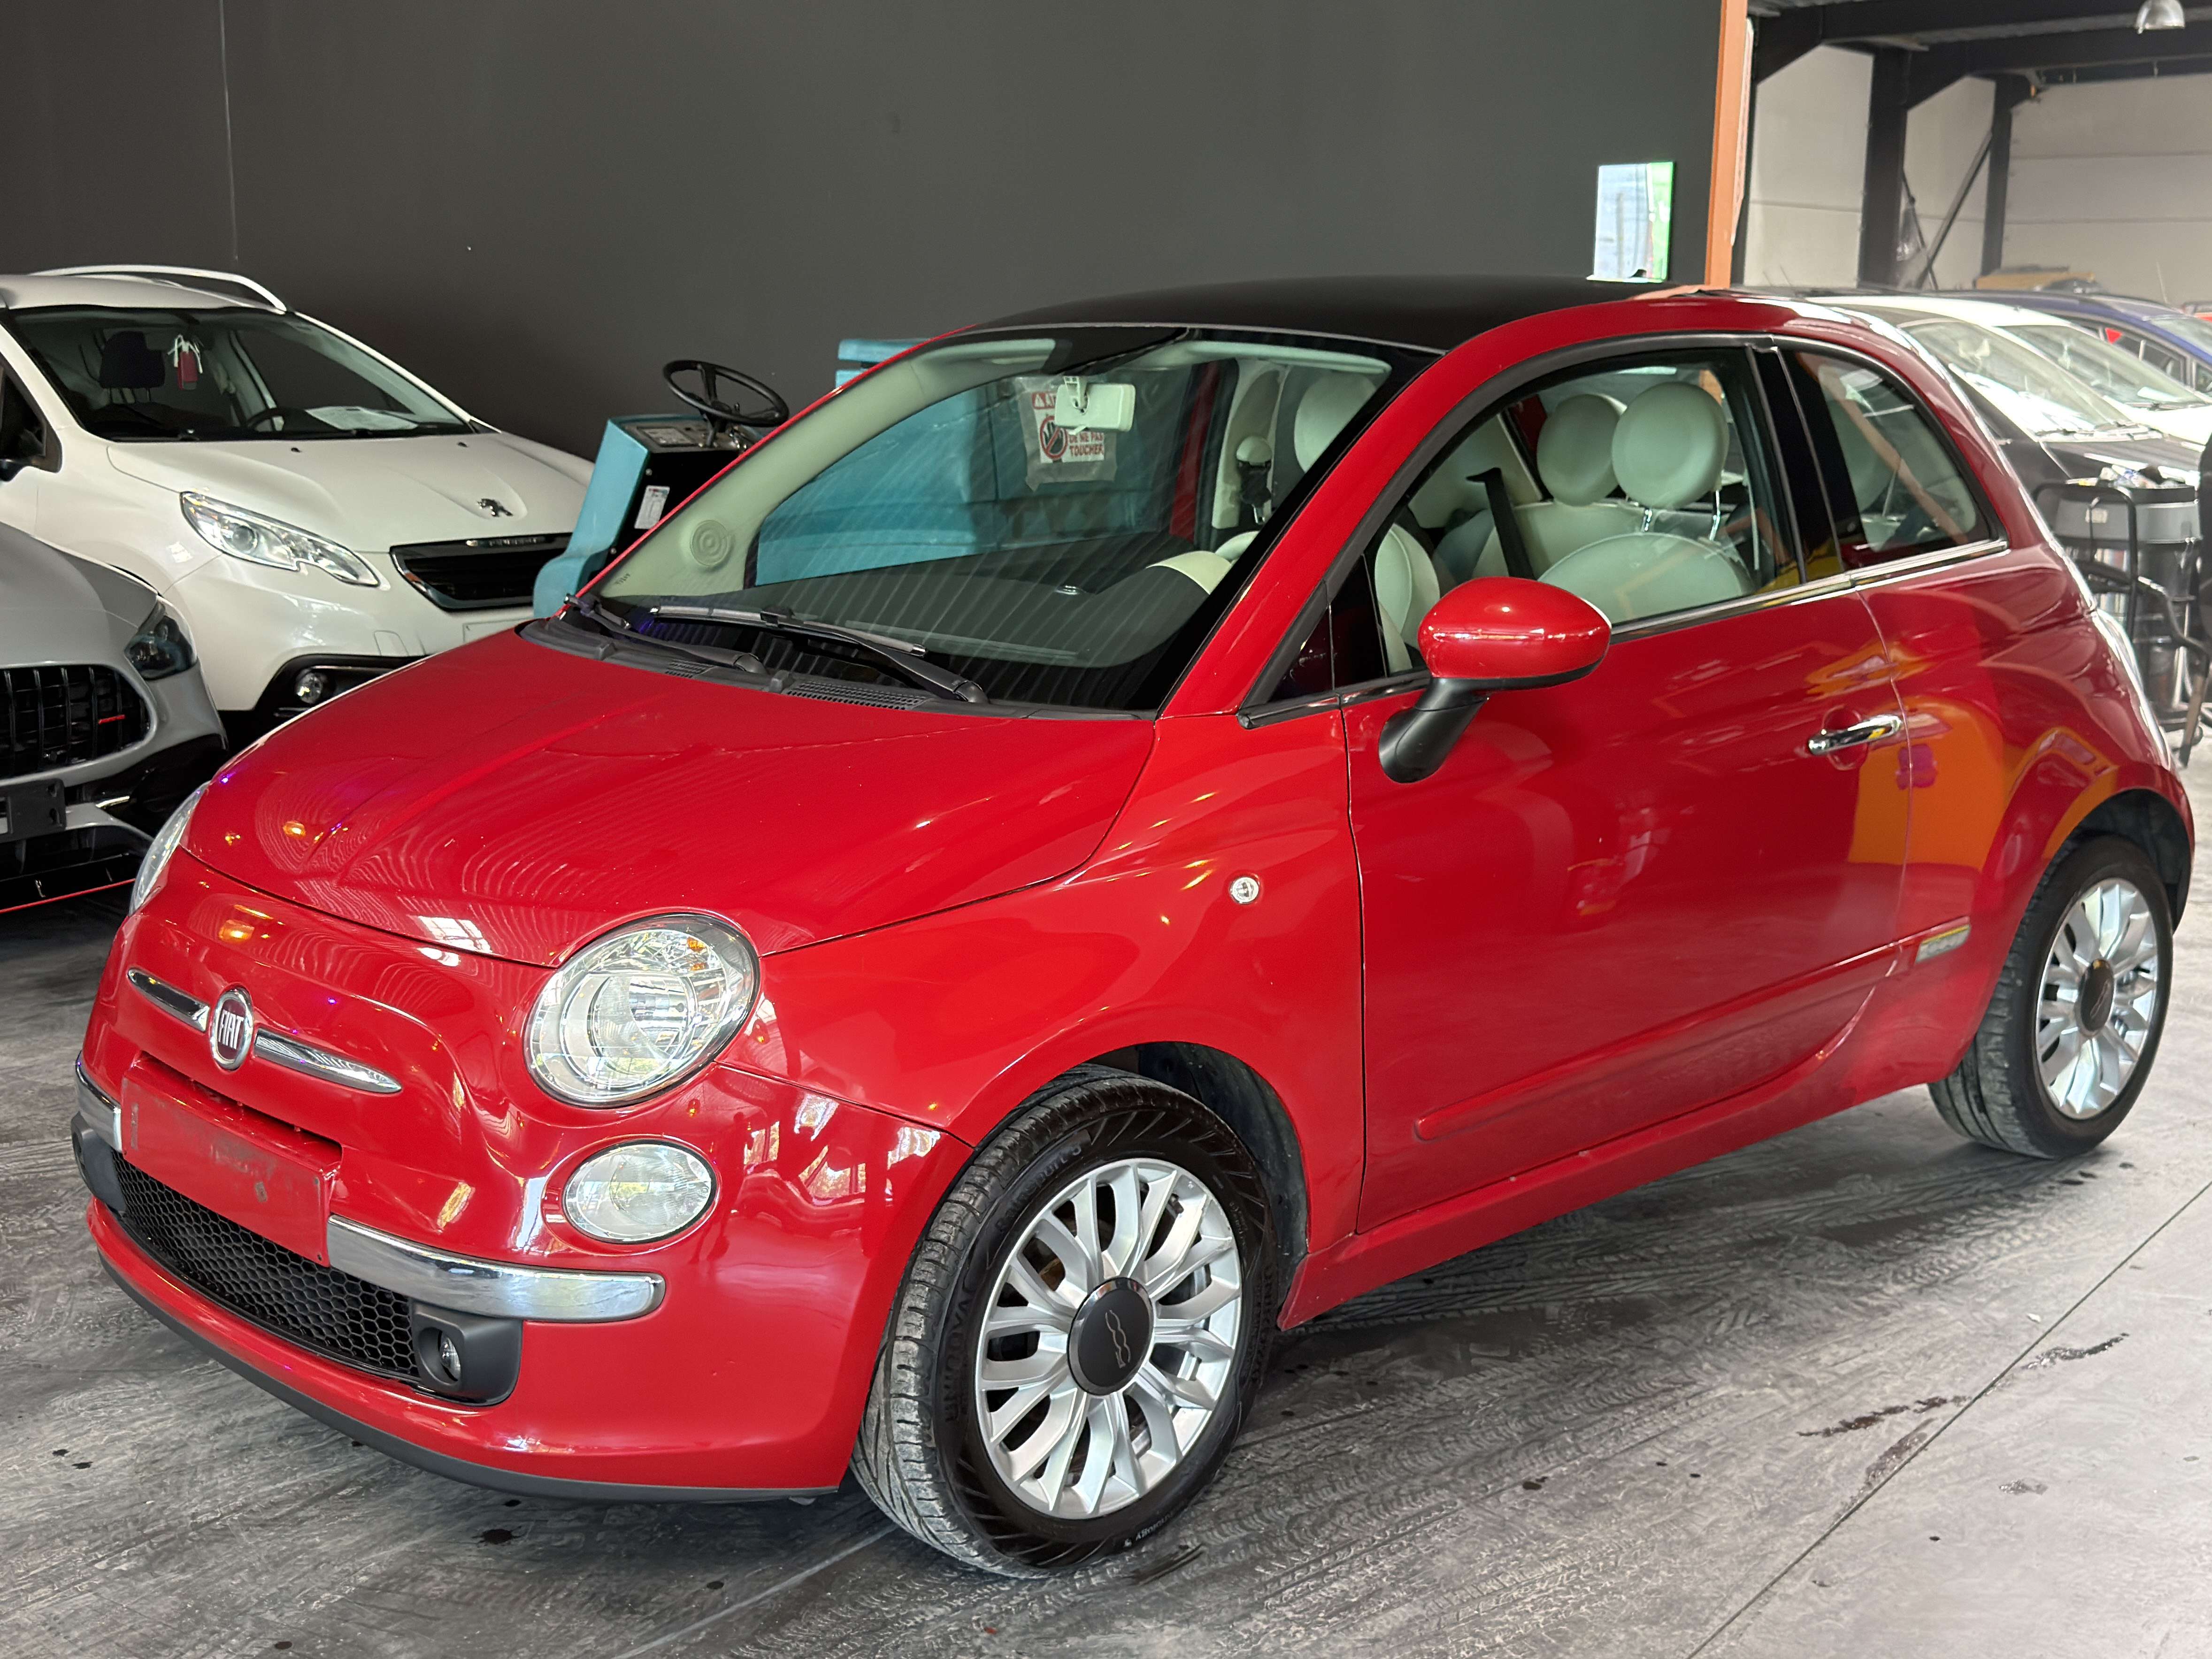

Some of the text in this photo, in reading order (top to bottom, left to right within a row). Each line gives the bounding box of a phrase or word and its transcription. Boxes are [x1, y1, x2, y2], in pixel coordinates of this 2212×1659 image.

[1079, 432, 1089, 442] NE
[1091, 431, 1104, 441] PAS
[1069, 444, 1104, 457] TOUCHER
[219, 1009, 244, 1050] FIAT
